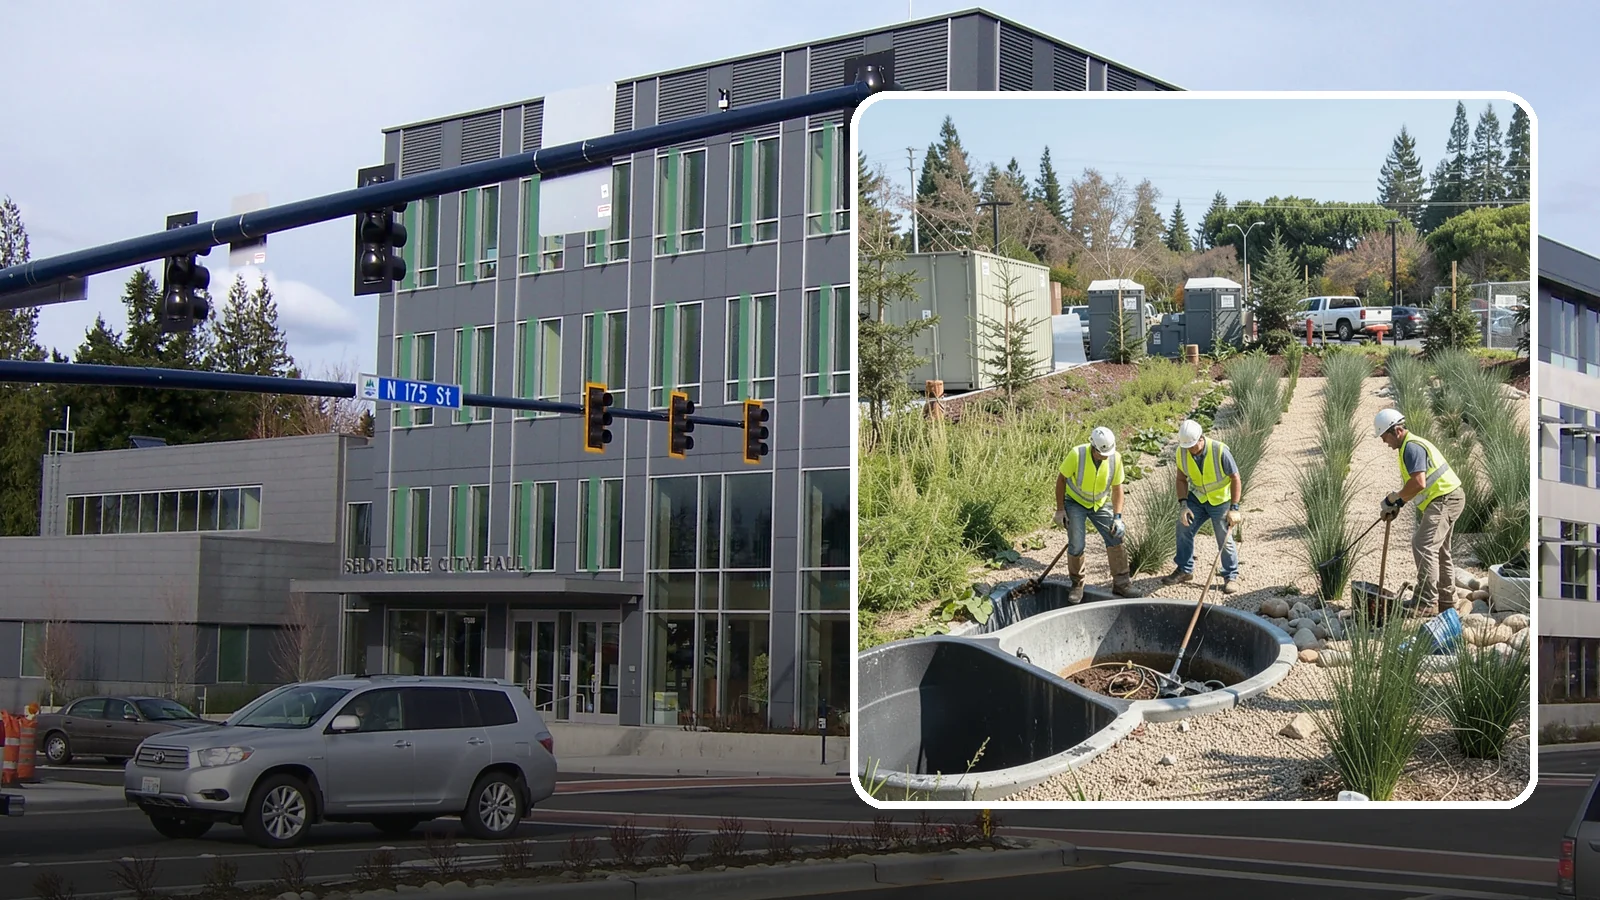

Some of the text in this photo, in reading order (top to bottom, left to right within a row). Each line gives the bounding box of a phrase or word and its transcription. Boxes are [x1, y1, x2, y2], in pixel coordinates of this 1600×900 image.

[387, 380, 451, 406] N 175 St
[344, 555, 526, 574] SHORELINE CITY HALL
